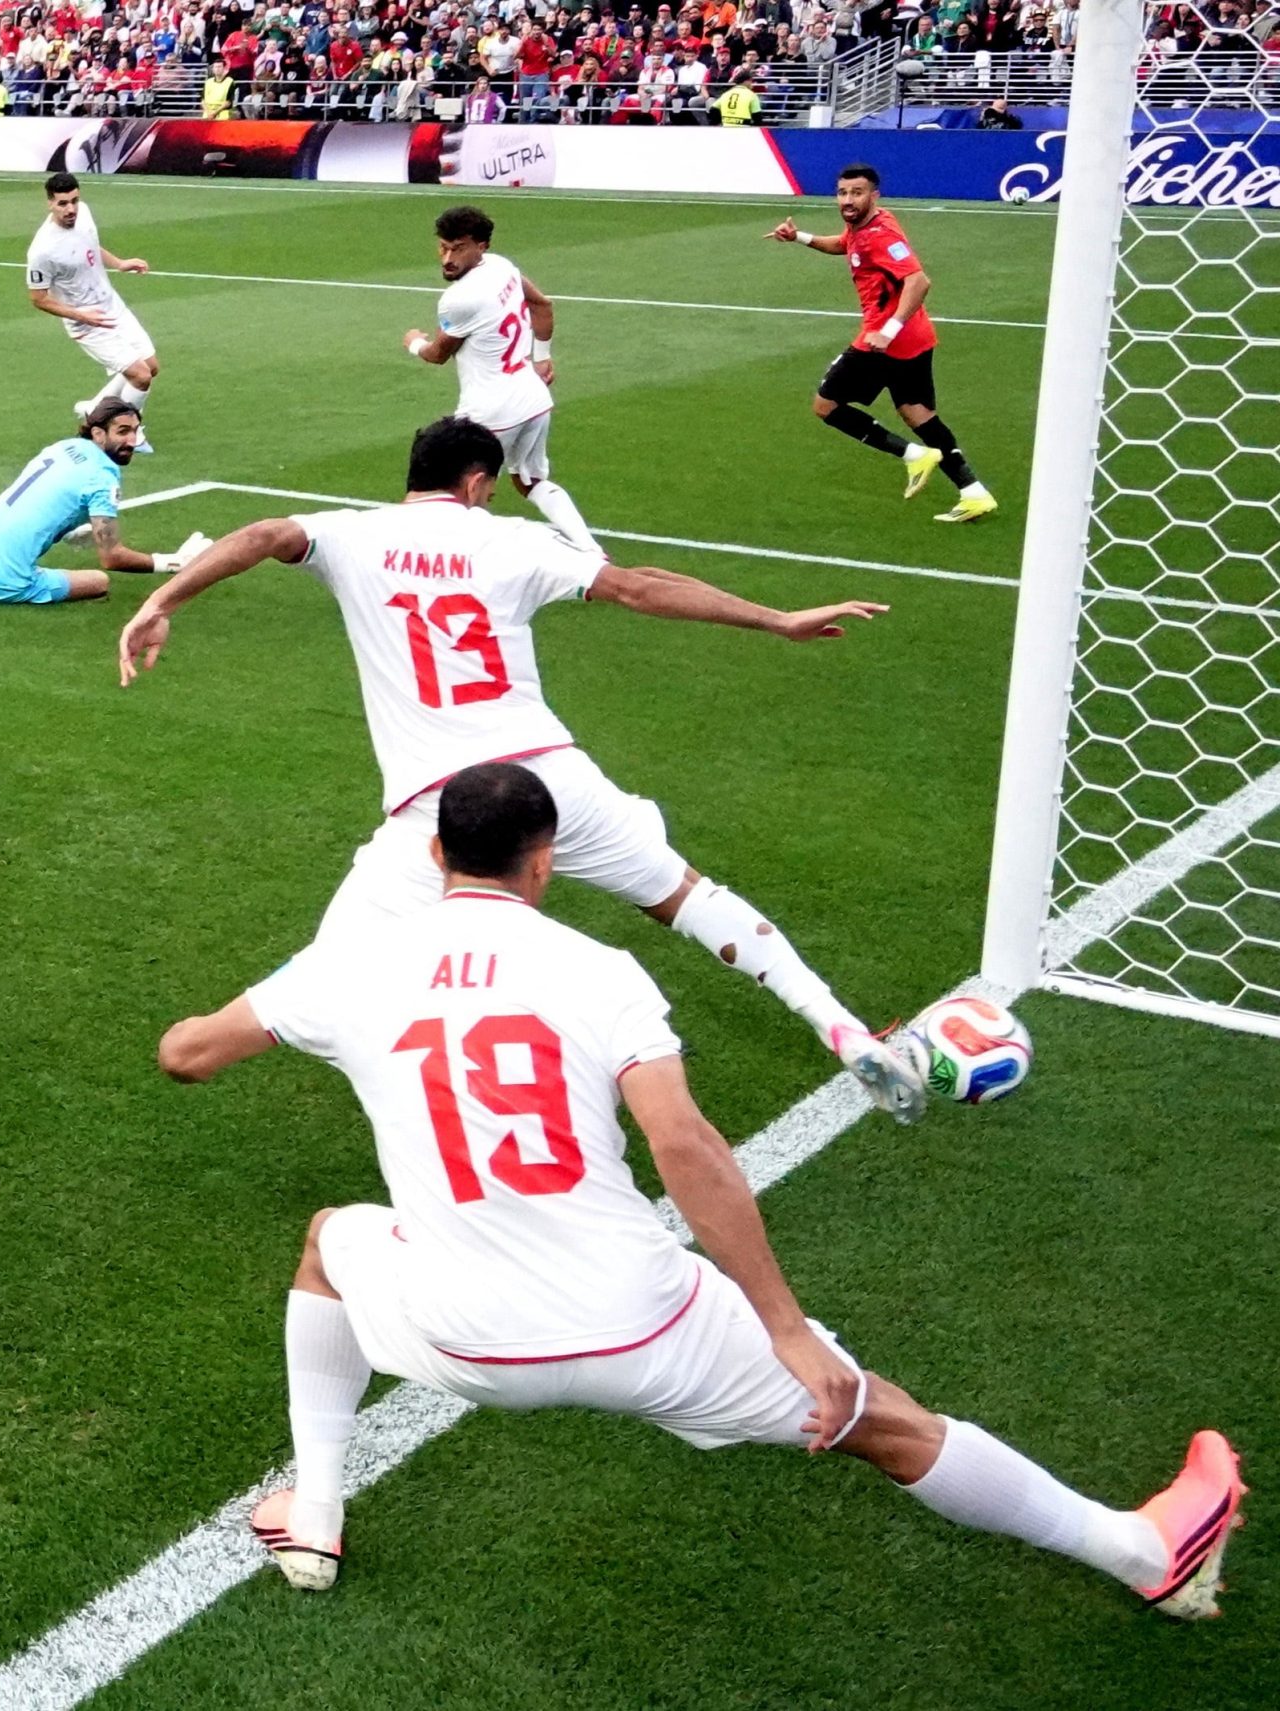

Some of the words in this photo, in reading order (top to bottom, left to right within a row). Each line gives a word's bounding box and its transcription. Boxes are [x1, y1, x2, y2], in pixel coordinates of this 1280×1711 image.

[483, 143, 546, 180] ULTRA
[6, 458, 55, 507] 1
[384, 549, 473, 579] KANANI
[384, 592, 513, 709] 13
[430, 952, 497, 989] ALI
[390, 1014, 587, 1204] 19
